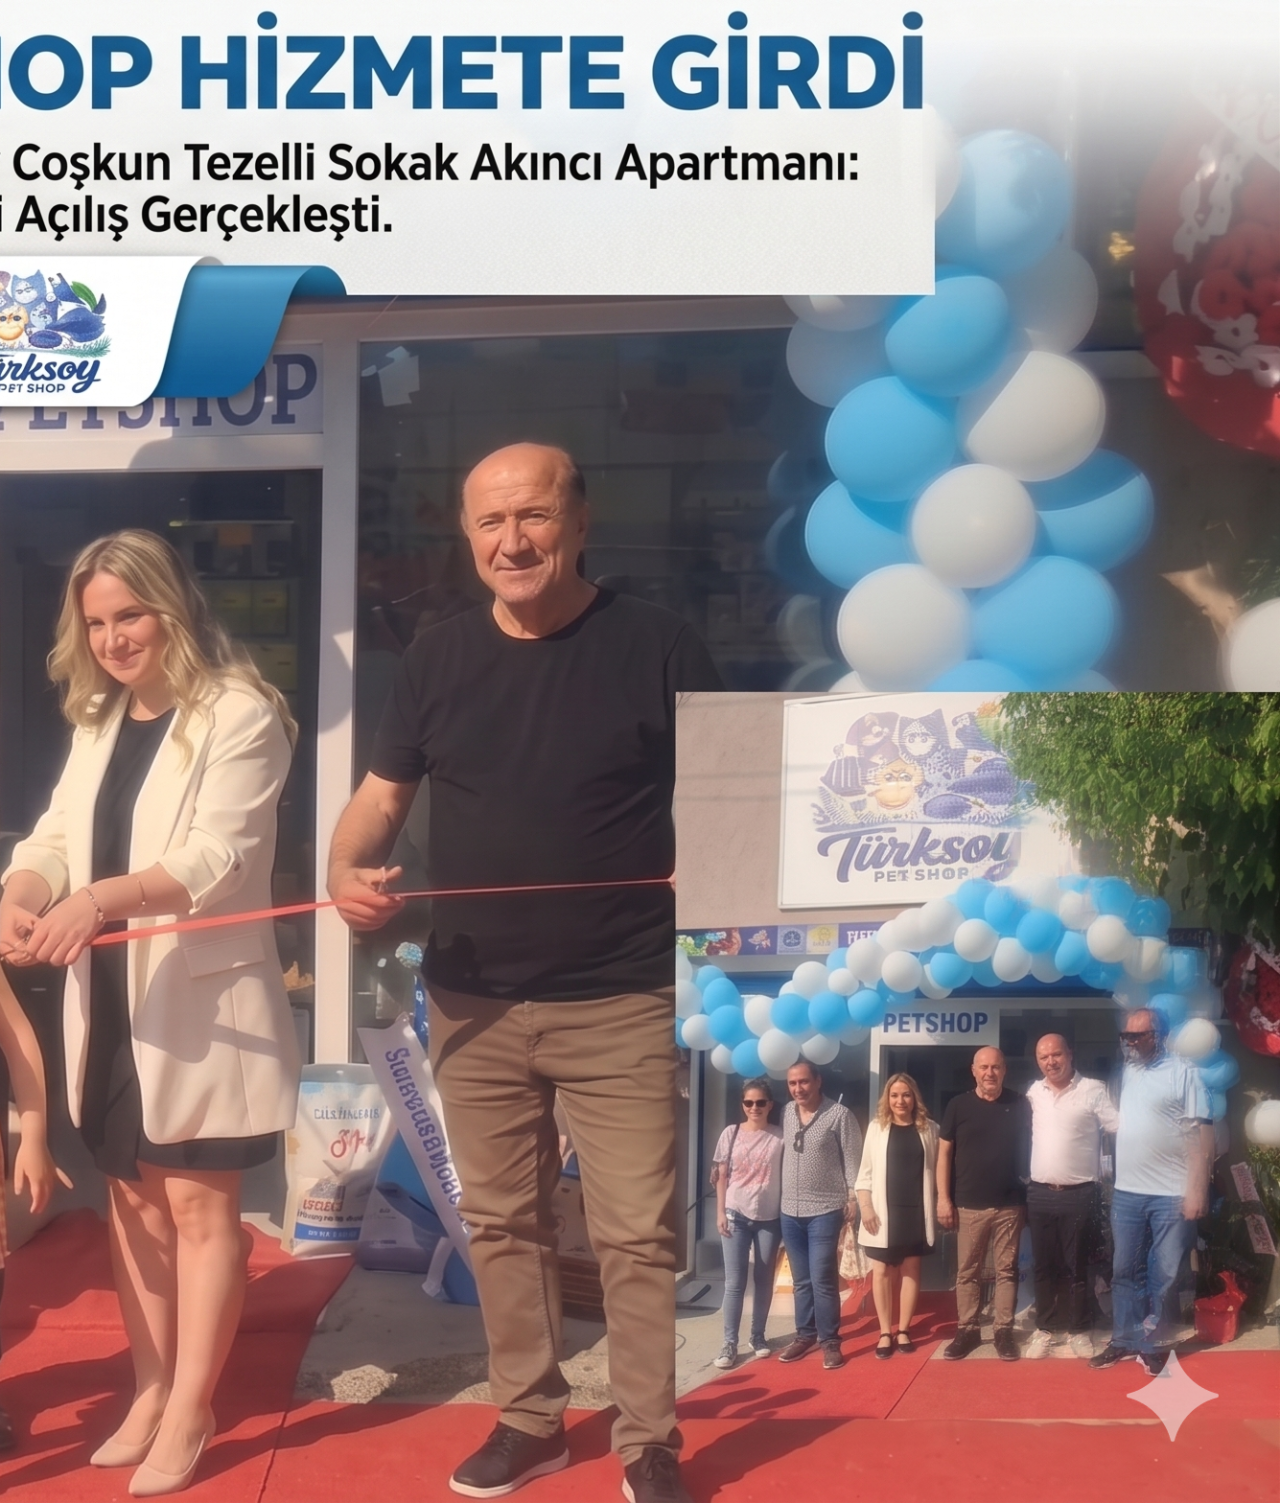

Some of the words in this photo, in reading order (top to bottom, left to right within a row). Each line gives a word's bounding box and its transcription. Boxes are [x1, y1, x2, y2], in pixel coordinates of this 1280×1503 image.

[816, 826, 1020, 883] Türksoy
[874, 869, 909, 883] PET
[913, 866, 969, 881] SHOP
[882, 1011, 989, 1034] PETSHOP
